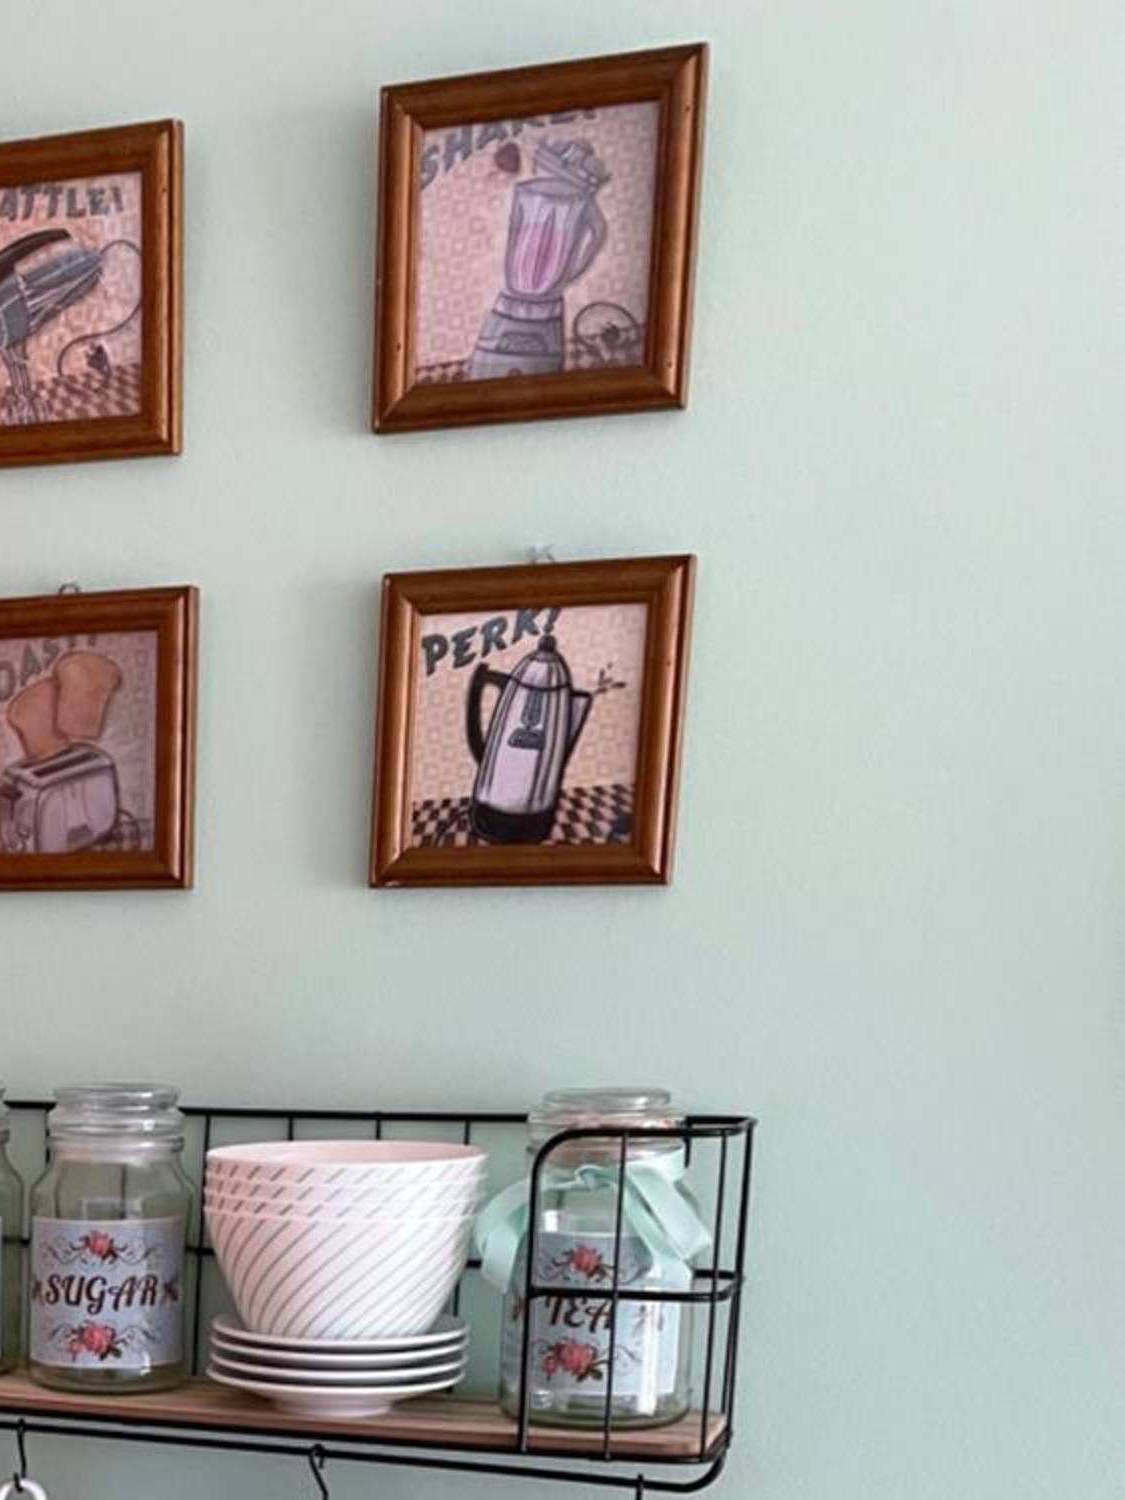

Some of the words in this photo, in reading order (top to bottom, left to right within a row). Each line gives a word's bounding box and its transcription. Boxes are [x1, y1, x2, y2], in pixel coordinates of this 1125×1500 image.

[421, 607, 562, 677] PERK!
[45, 1273, 158, 1315] SUGAR
[545, 1296, 613, 1334] TEA
